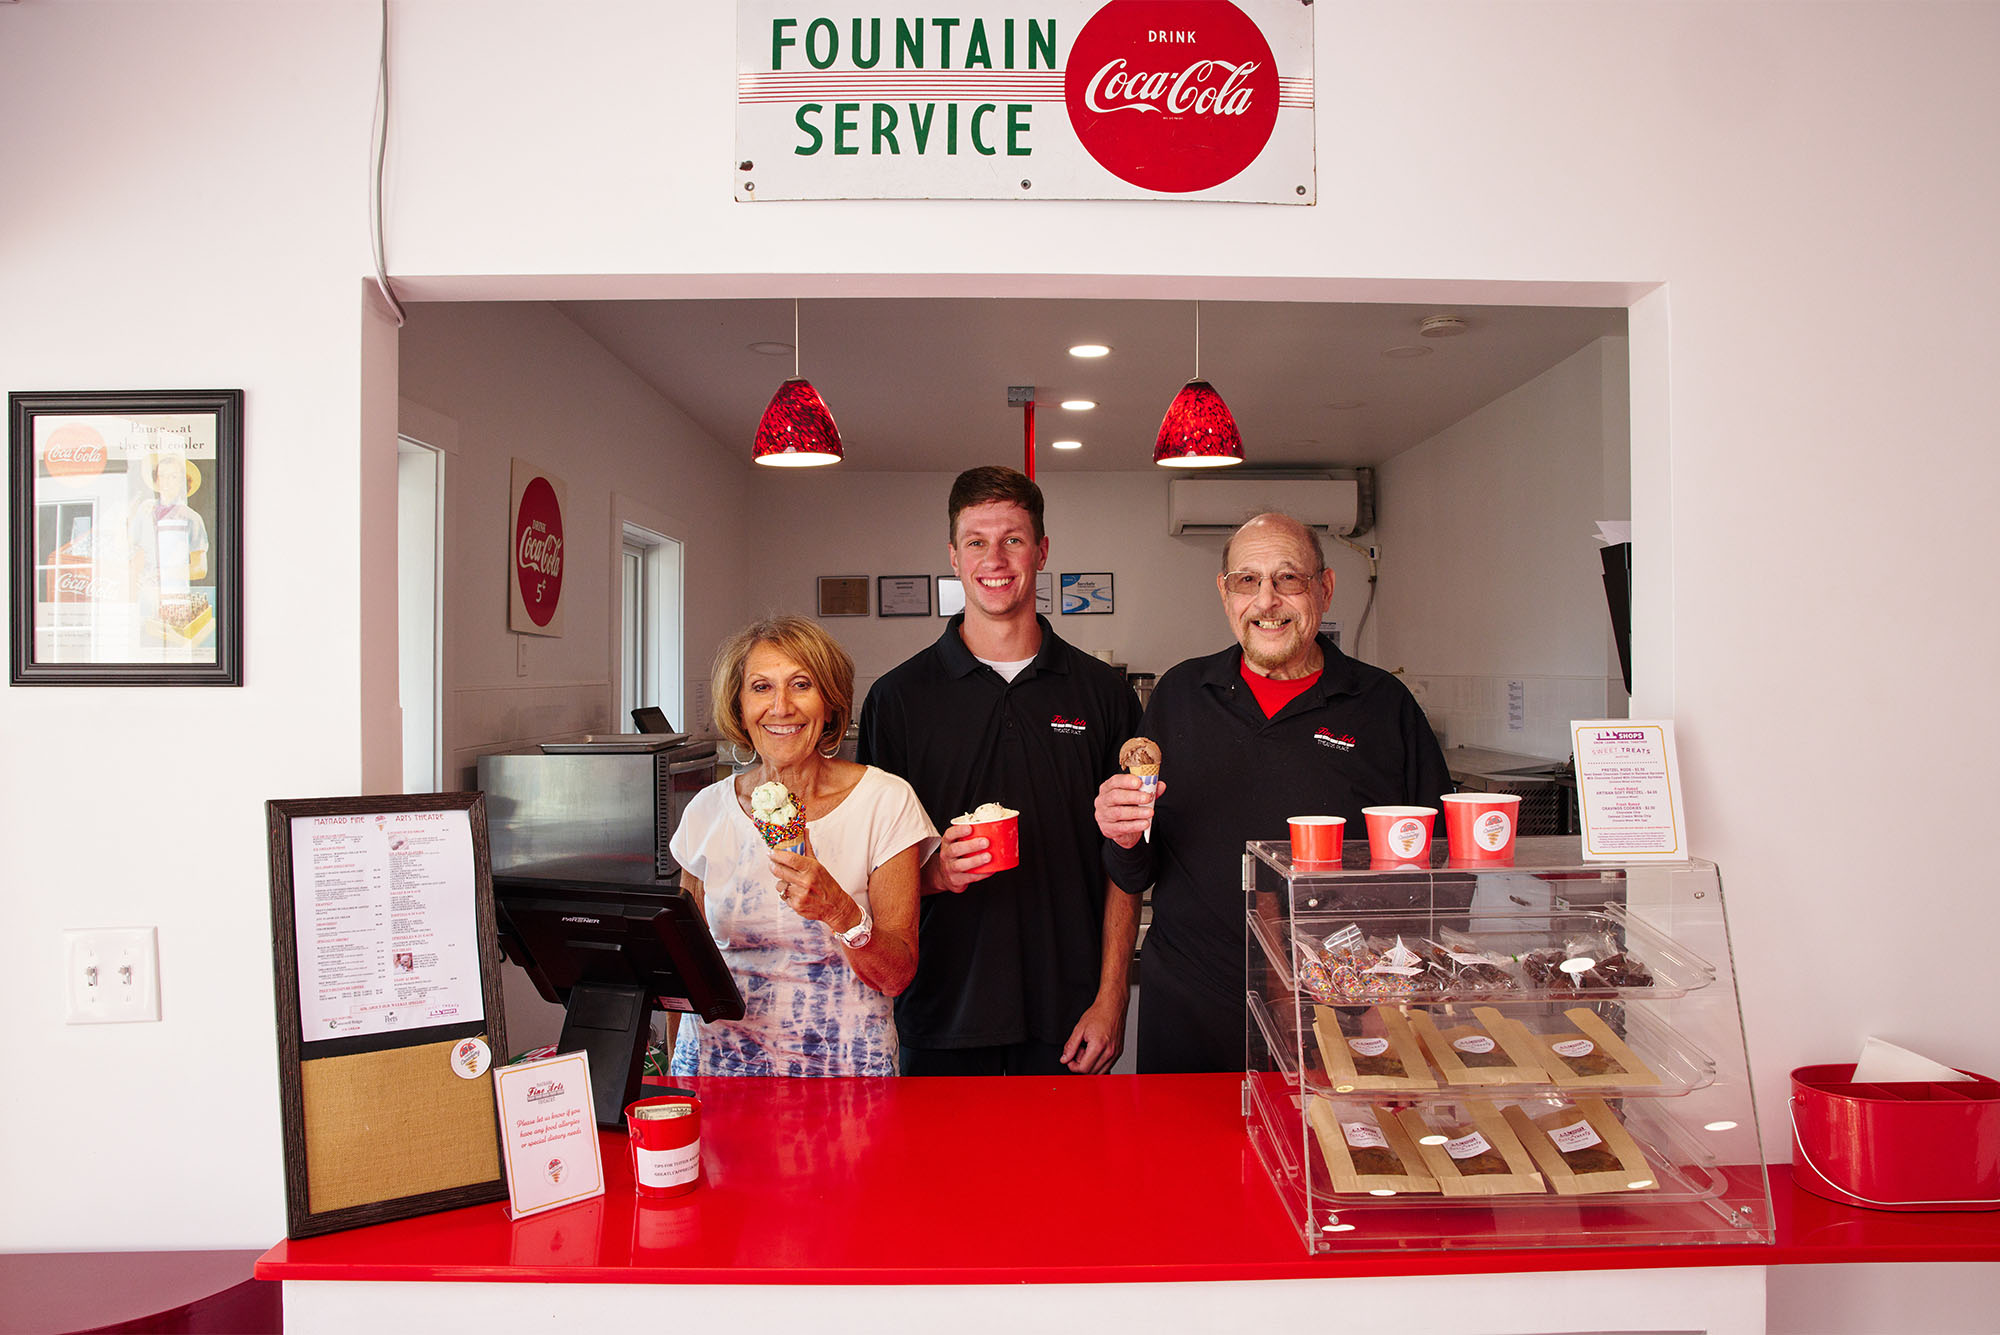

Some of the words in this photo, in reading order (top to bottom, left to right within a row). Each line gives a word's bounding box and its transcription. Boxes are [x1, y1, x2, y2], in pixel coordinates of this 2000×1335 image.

[1148, 30, 1196, 43] DRINK
[771, 17, 1057, 71] FOUNTAIN
[1084, 58, 1262, 115] Coca-Cola
[794, 103, 1034, 156] SERVICE
[143, 437, 161, 450] red
[532, 519, 547, 534] DRINK
[1619, 732, 1643, 740] SHOPS
[395, 814, 412, 822] ARTS
[527, 1086, 545, 1097] Fine
[546, 1082, 564, 1093] Arts
[516, 1119, 535, 1128] Please
[545, 1122, 557, 1133] food
[527, 1136, 546, 1147] special
